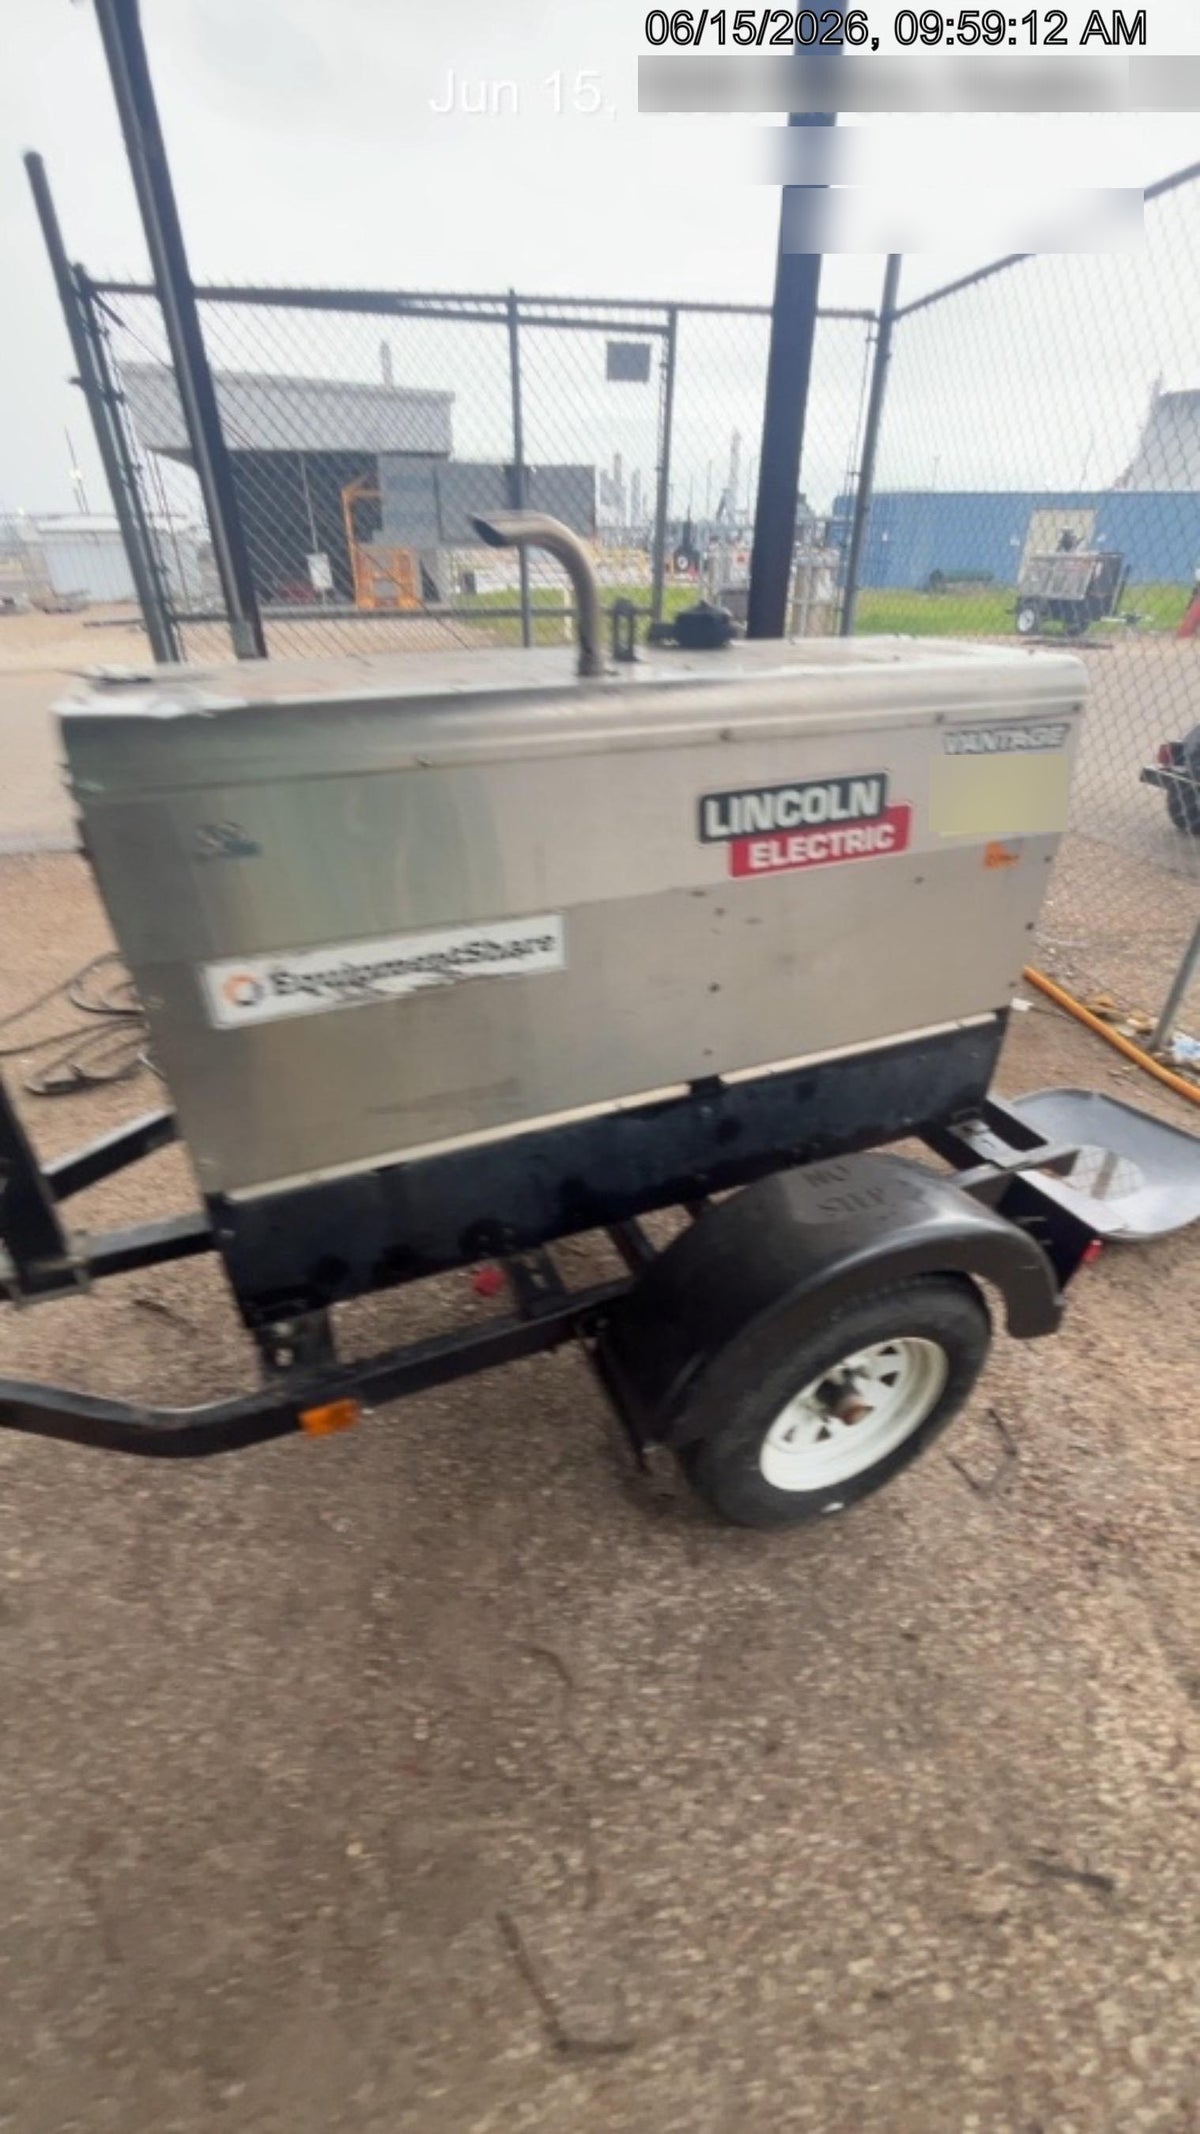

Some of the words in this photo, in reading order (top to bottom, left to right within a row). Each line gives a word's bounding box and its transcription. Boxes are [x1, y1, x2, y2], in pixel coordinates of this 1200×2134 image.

[944, 724, 1069, 755] VANTAGE
[705, 778, 881, 837] LINCOLN
[748, 823, 896, 869] ELECTRIC
[269, 934, 556, 997] EquipmentShare
